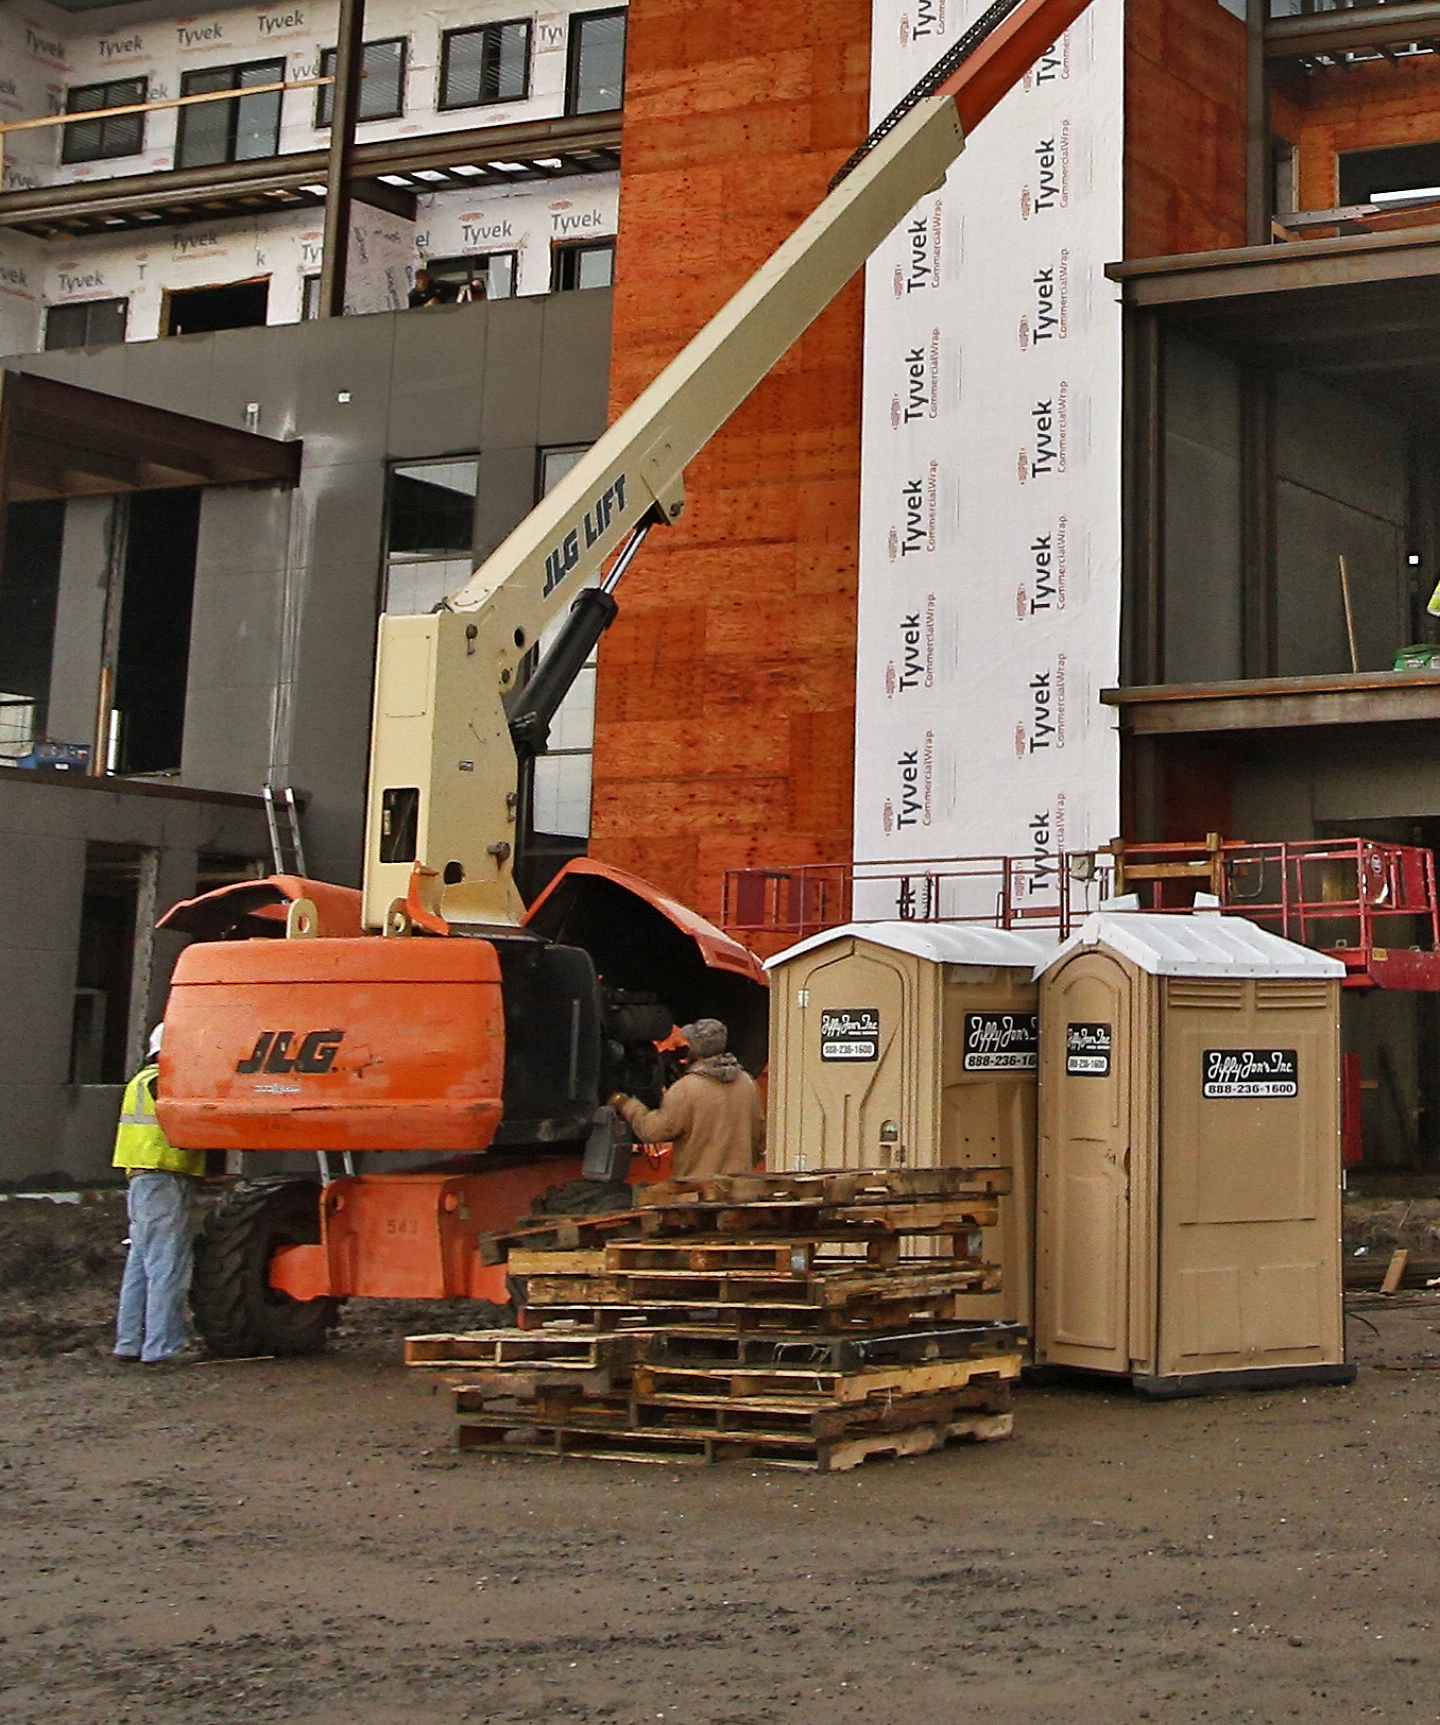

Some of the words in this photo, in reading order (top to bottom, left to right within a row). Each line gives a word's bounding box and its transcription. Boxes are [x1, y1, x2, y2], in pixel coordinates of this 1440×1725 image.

[26, 29, 65, 58] Tyvek
[99, 36, 143, 56] Tyvek
[176, 23, 222, 44] Tyvek
[258, 10, 303, 32] Tyvek
[1035, 139, 1059, 213] Tyvek
[1061, 120, 1070, 208] CommercialWrap
[174, 231, 218, 250] Tyvek
[463, 222, 511, 242] Tyvek
[551, 210, 602, 230] Tyvek
[907, 217, 931, 293] Tyvek
[931, 200, 942, 288] CommercialWrap
[60, 273, 104, 293] Tyvek
[1033, 268, 1058, 345] Tyvek
[1059, 249, 1069, 339] CommercialWrap
[904, 347, 929, 424] Tyvek
[929, 327, 940, 418] CommercialWrap
[1032, 400, 1057, 478] Tyvek
[1057, 381, 1068, 473] CommercialWrap
[543, 528, 579, 598] JLG
[584, 474, 626, 549] LIFT
[902, 480, 927, 556] Tyvek
[927, 459, 938, 552] CommercialWrap
[1031, 535, 1056, 615] Tyvek
[1057, 516, 1067, 609] CommercialWrap
[900, 614, 925, 692] Tyvek
[925, 594, 936, 688] CommercialWrap
[1029, 672, 1055, 754] Tyvek
[1057, 653, 1066, 748] CommercialWrap
[897, 751, 922, 830] Tyvek
[923, 731, 934, 826] CommercialWrap
[1029, 812, 1052, 894] Tyvek
[236, 1031, 345, 1073] JLG
[968, 1055, 1037, 1066] 888-236-16
[969, 1016, 1000, 1052] Jiffy
[1001, 1016, 1029, 1048] Jon's
[1208, 1052, 1241, 1082] Jiffy
[1241, 1052, 1270, 1078] Jon's
[1208, 1085, 1293, 1094] 888-236-1600
